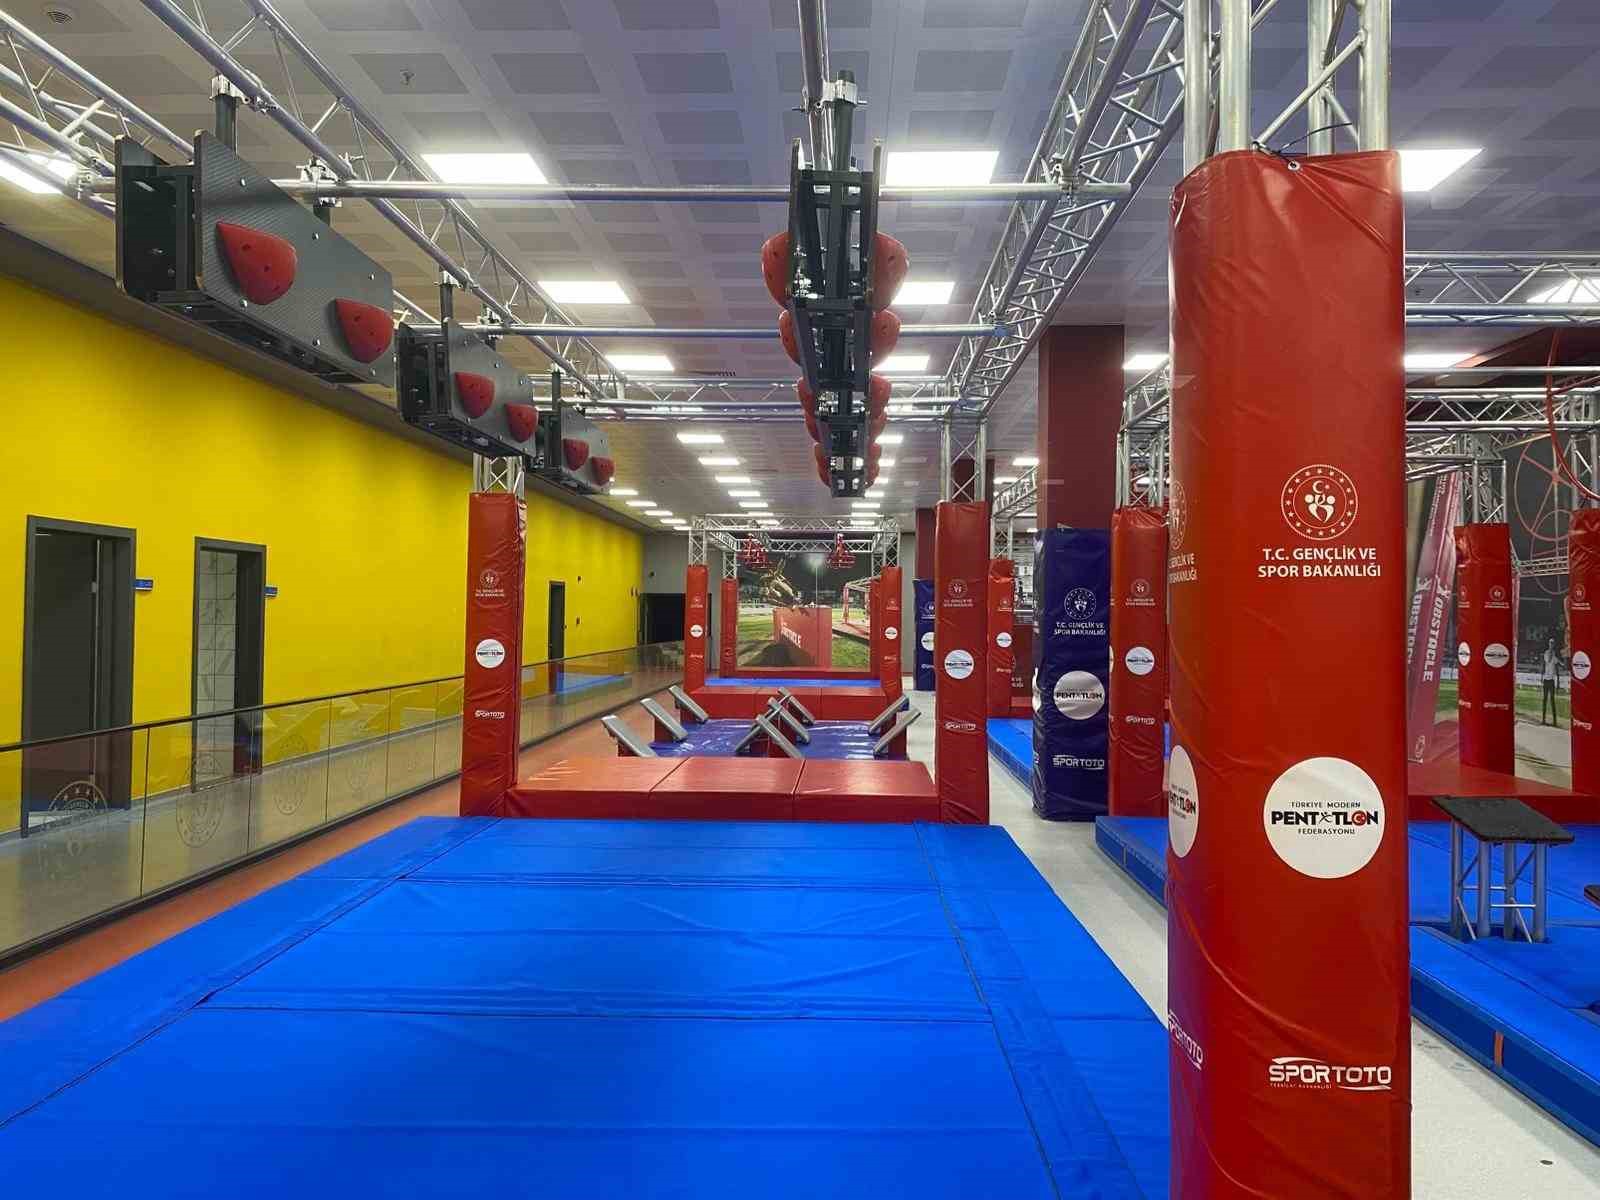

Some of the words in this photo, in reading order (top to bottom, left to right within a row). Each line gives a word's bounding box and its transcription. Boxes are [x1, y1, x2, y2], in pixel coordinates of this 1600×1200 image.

[1262, 548, 1289, 560] T.C.
[1293, 545, 1356, 563] GENÇLİK
[1358, 548, 1377, 560] VE
[1258, 565, 1299, 577] SPOR
[1303, 563, 1381, 577] BAKANLIĞI
[1053, 757, 1104, 767] SPORTOTO
[1298, 828, 1355, 836] FEDERASYONU
[1269, 1063, 1392, 1085] SPORTOTO
